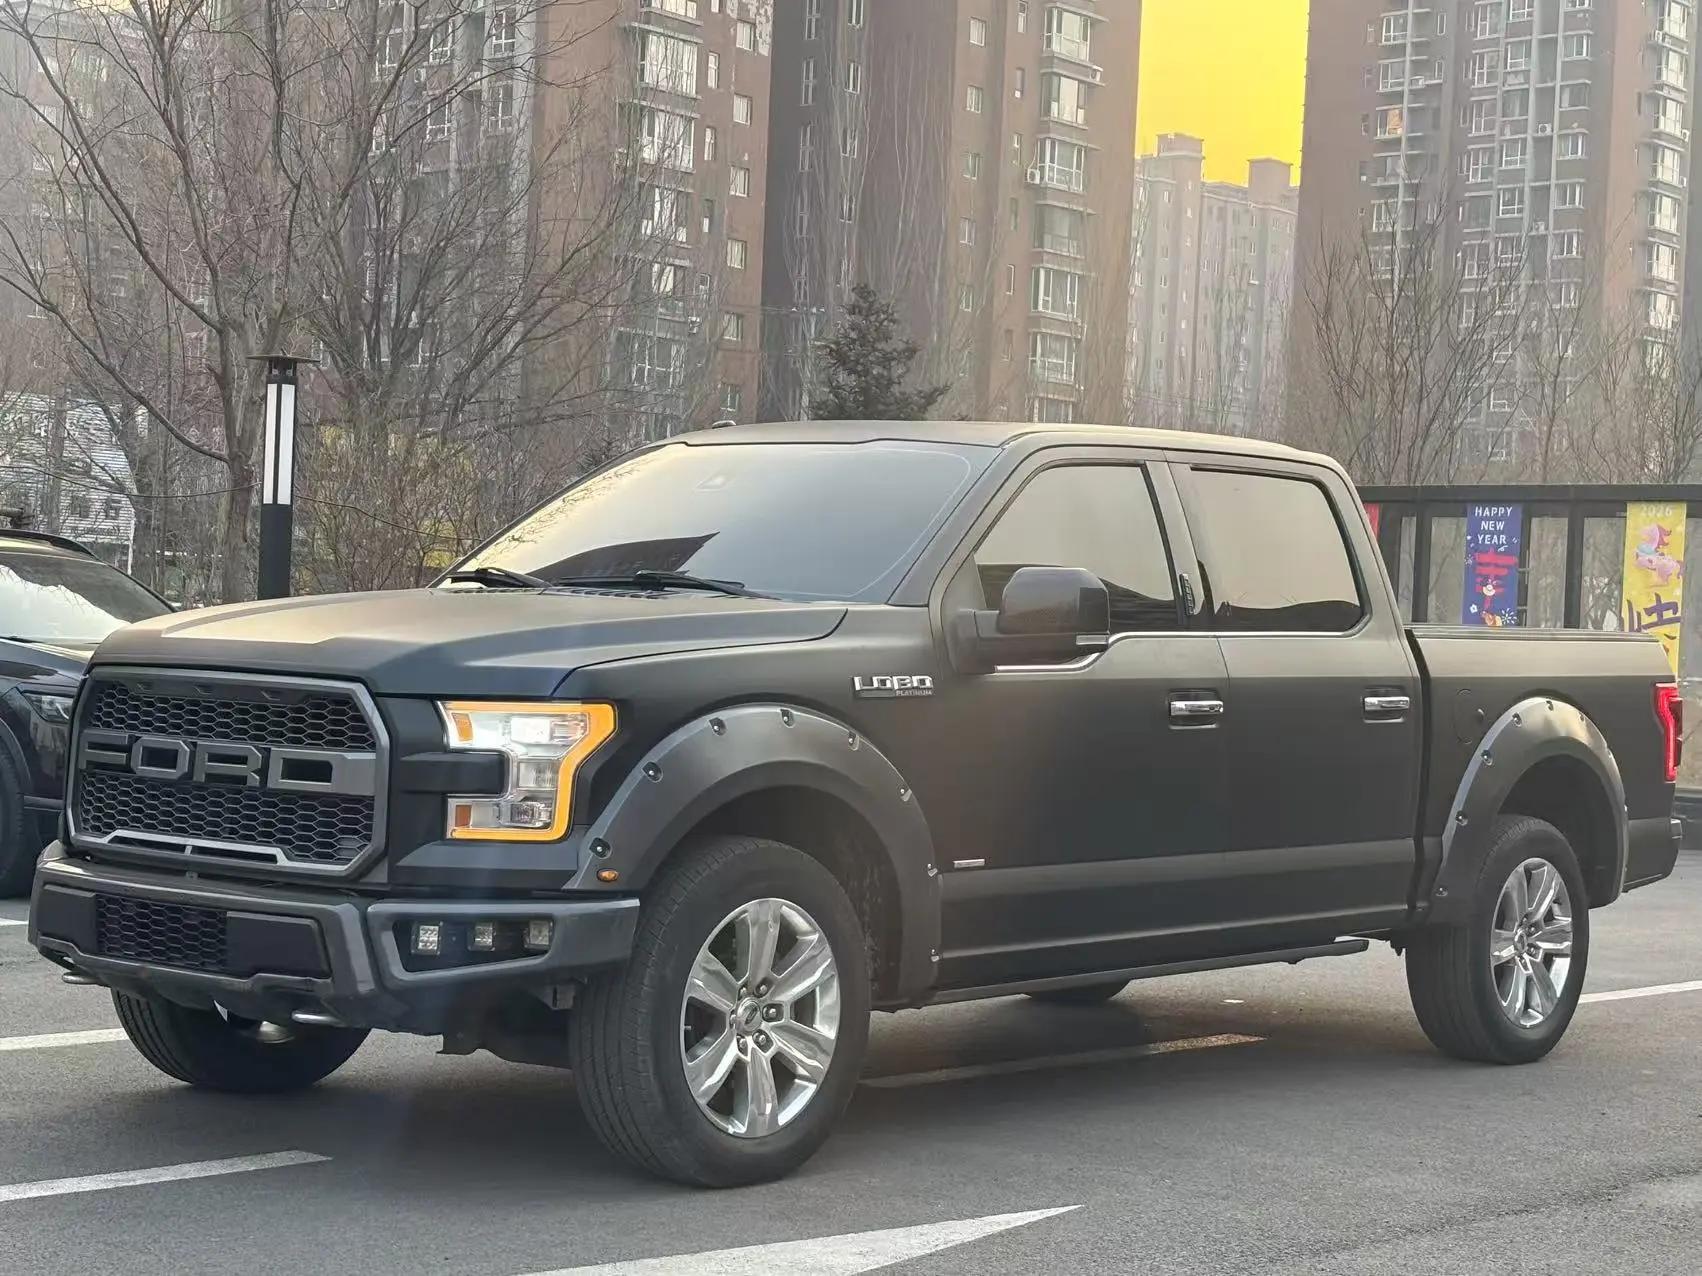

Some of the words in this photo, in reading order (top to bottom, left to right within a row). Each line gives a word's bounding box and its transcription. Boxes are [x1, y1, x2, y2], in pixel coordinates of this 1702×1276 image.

[1474, 506, 1513, 517] HAPPY
[1639, 504, 1673, 517] 2026
[1480, 520, 1505, 531] NEW
[1477, 534, 1507, 545] YEAR
[853, 675, 934, 691] LOBO
[79, 728, 352, 794] FORD
